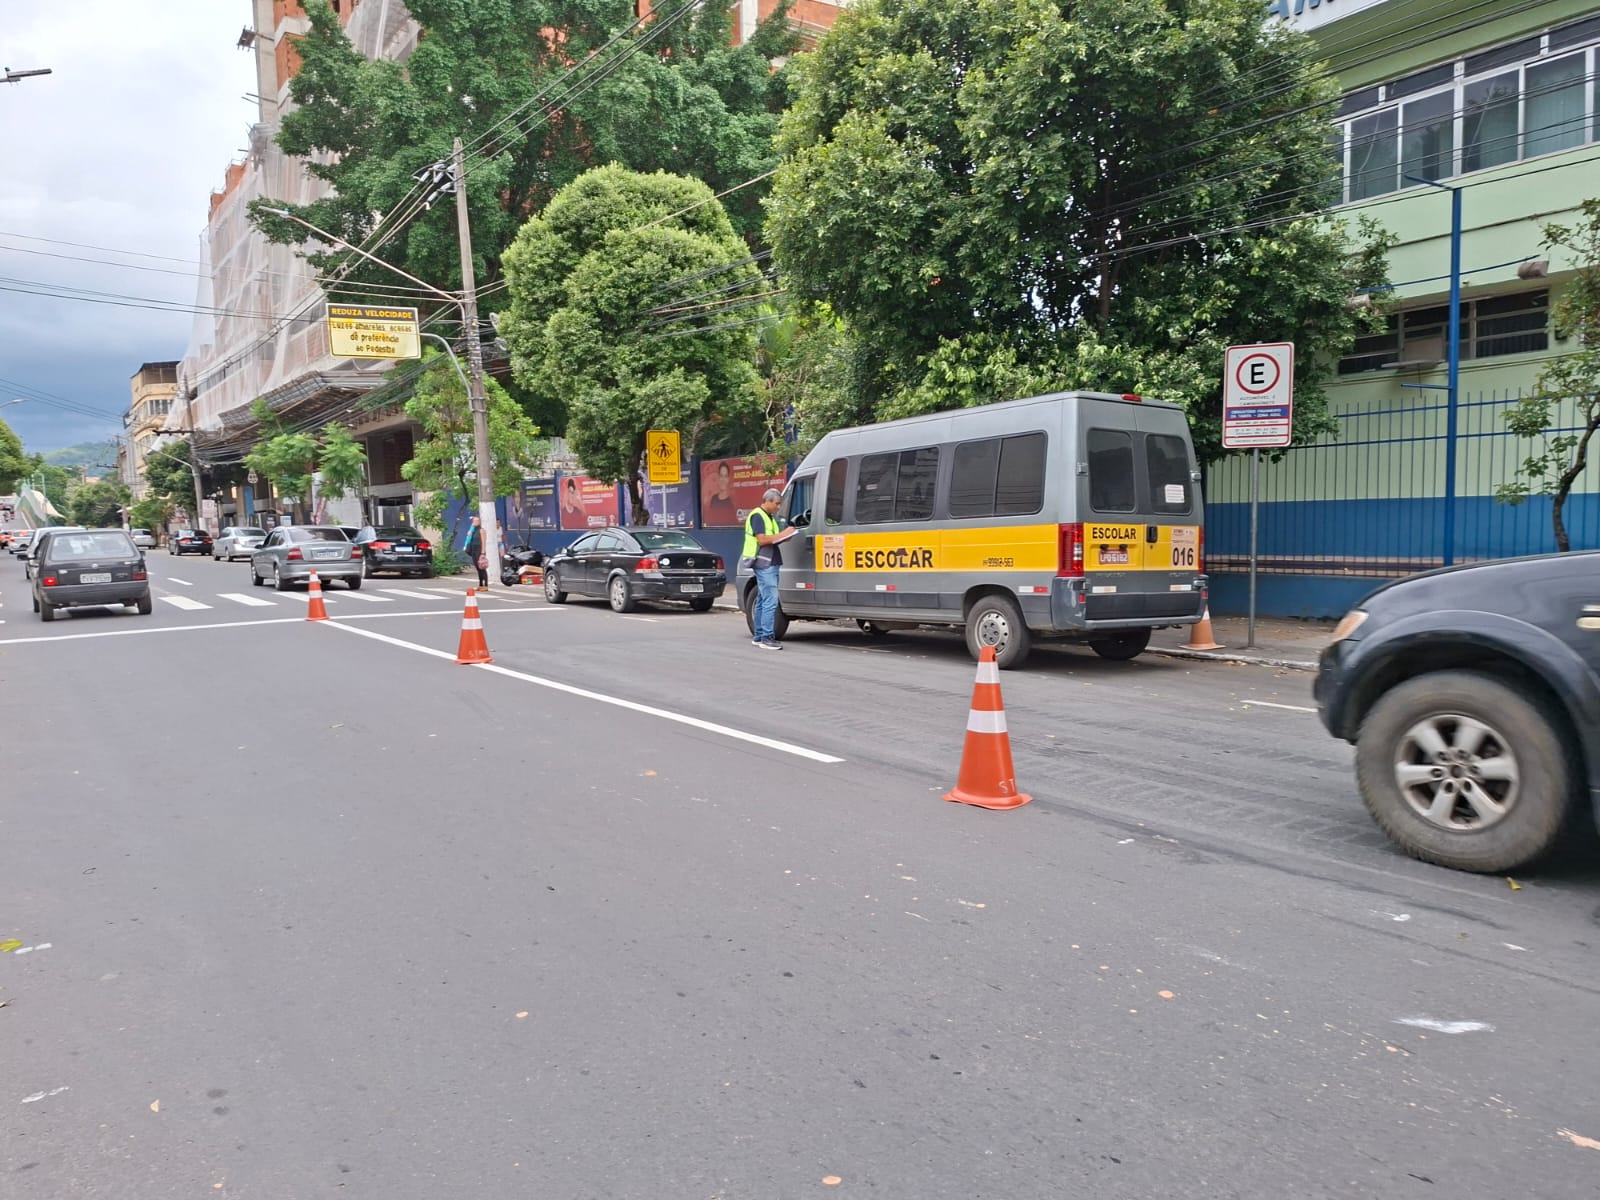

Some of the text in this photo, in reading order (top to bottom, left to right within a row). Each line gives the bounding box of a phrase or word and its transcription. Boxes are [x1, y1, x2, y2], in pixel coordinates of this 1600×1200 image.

[331, 307, 412, 319] REDUZA VELOCIDADE
[350, 331, 400, 343] dê preferência
[1250, 362, 1265, 385] E
[1092, 527, 1137, 540] ESCOLAR
[824, 552, 843, 568] 016
[854, 549, 934, 568] ESCOLAR
[1172, 547, 1194, 566] 016
